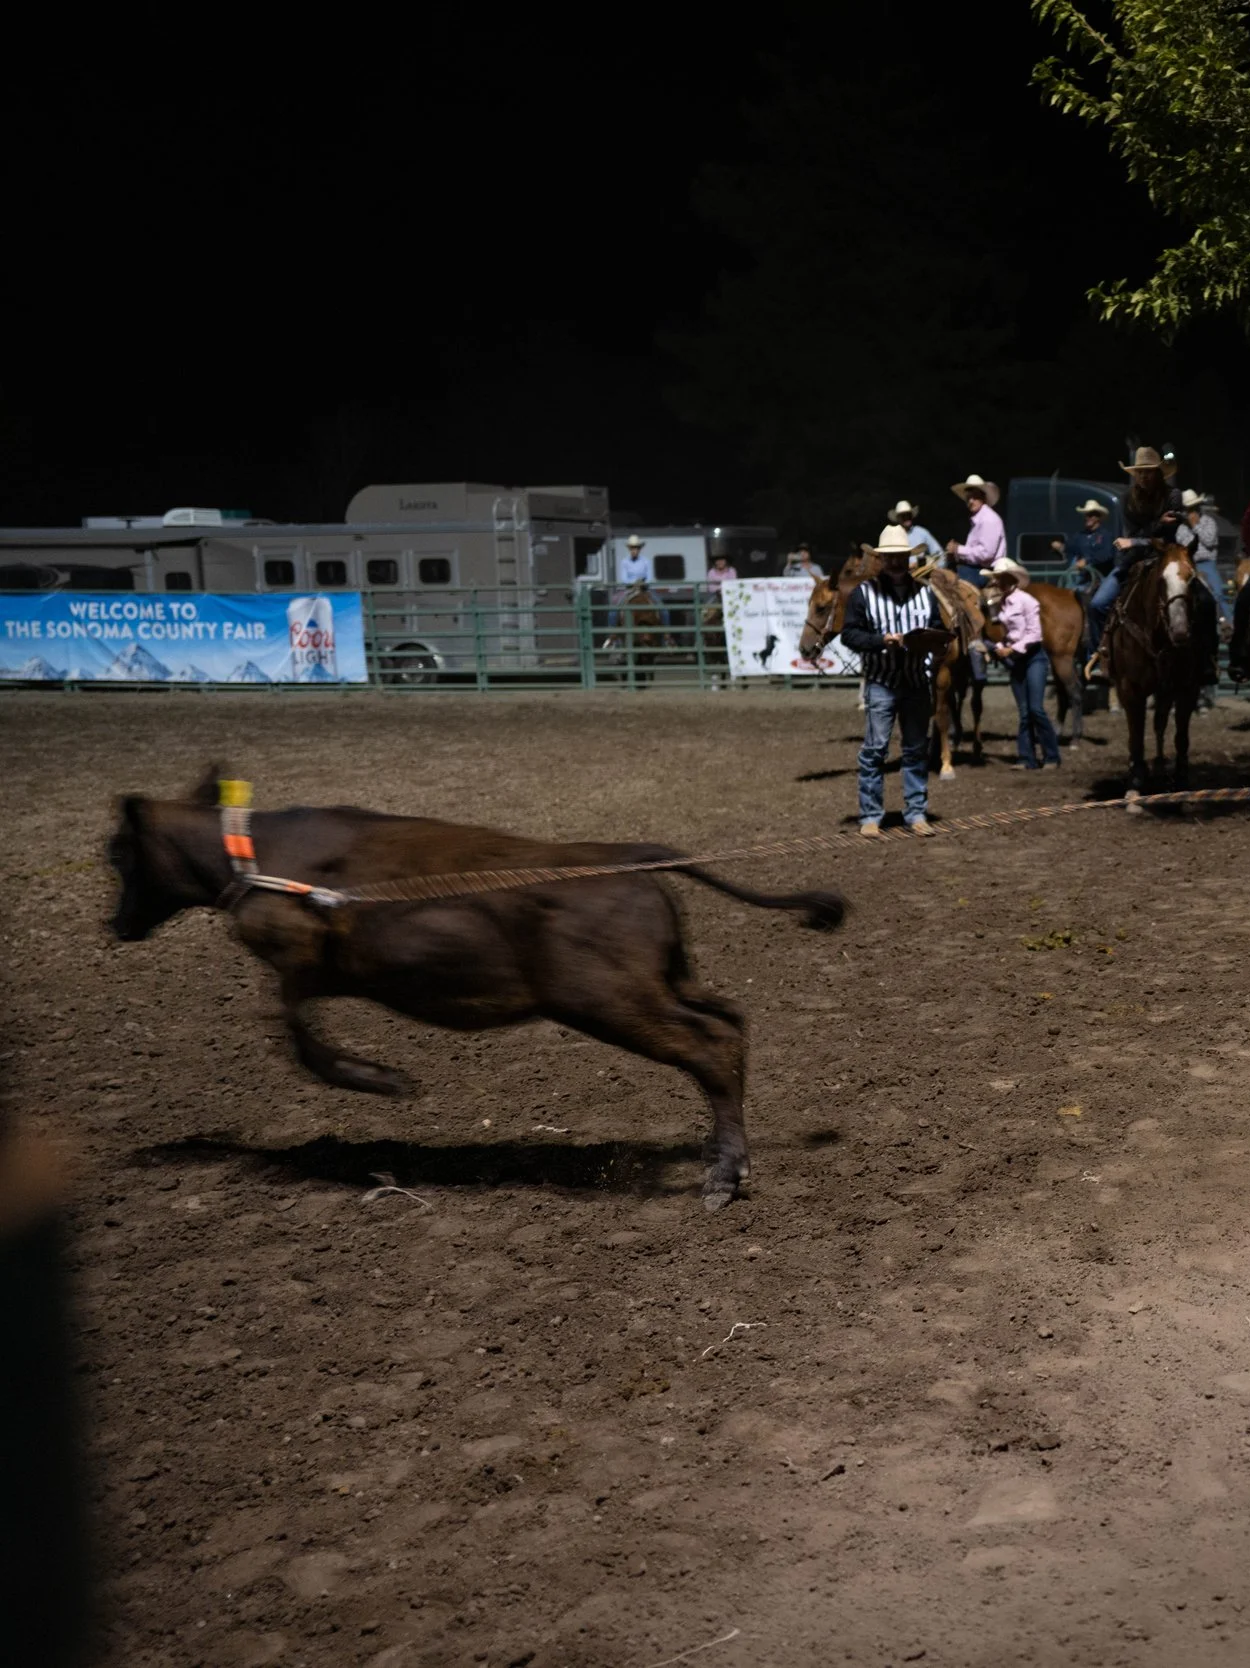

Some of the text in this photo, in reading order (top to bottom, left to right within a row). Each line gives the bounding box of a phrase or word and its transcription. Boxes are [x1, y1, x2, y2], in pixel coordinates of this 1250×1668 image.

[69, 601, 197, 621] WELCOME TO
[4, 620, 266, 641] THE SONOMA COUNTY FAIR
